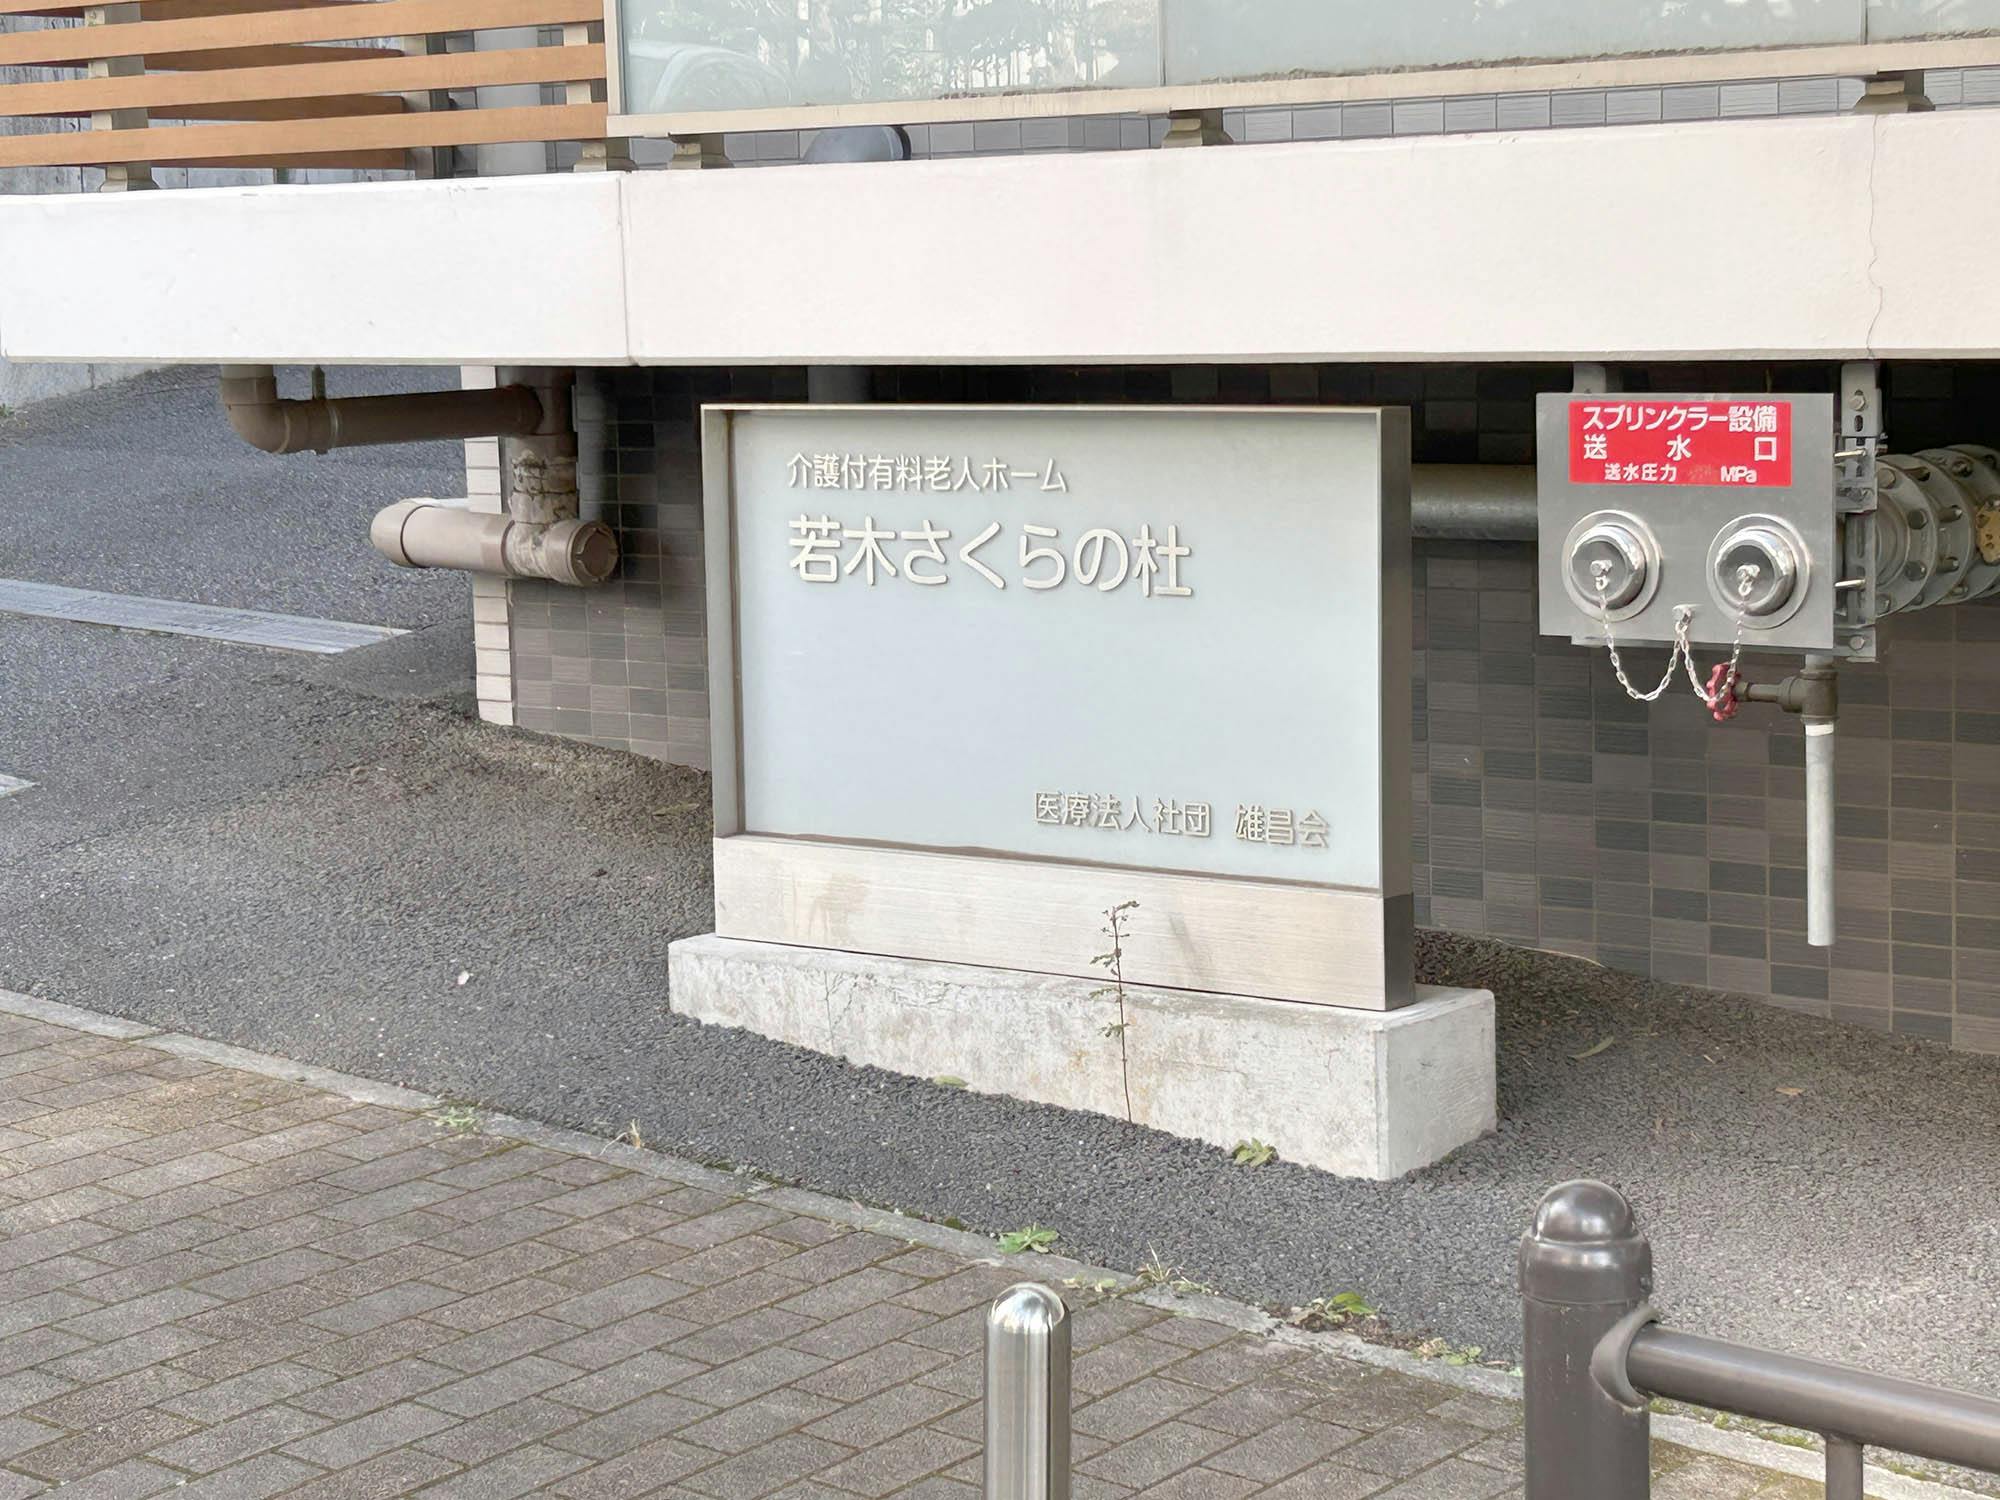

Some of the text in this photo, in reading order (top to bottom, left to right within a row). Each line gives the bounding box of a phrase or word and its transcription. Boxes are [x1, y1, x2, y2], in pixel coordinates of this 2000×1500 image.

[1582, 405, 1777, 433] スプリンクラー設備
[786, 453, 1068, 492] 介護付有料老人ホーム
[1604, 463, 1677, 482] 送水圧力
[1720, 465, 1758, 483] MPa
[788, 514, 1194, 597] 若木さくらの杜
[1034, 790, 1330, 849] 医療法人社団 雄昌会
